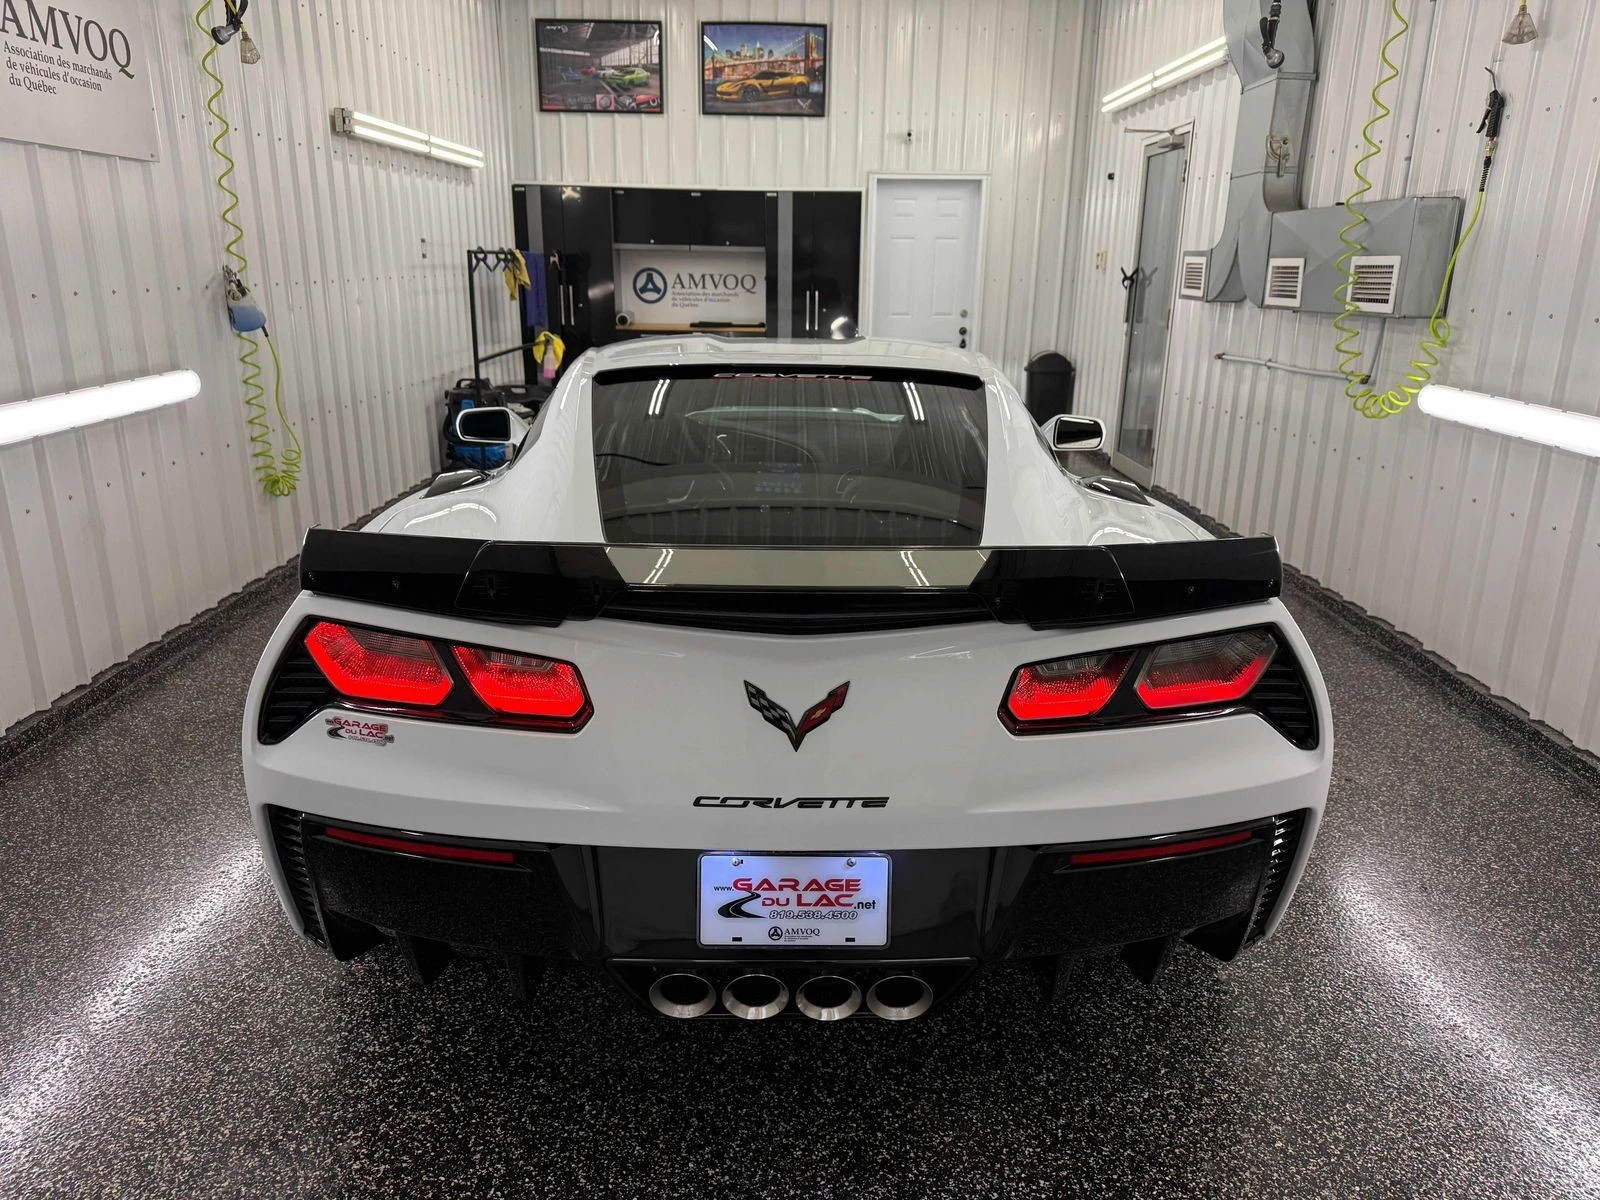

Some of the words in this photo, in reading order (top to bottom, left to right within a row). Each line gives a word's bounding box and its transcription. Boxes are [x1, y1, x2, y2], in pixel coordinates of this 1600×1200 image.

[0, 0, 135, 80] AMVOQ
[4, 40, 55, 66] Association
[56, 55, 71, 70] des
[72, 61, 113, 81] marchands
[6, 57, 18, 71] de
[20, 62, 61, 81] véhicules
[62, 71, 103, 92] d'occasion
[9, 73, 21, 88] du
[23, 76, 57, 95] Québec
[671, 272, 758, 295] AMVOQ
[333, 717, 388, 732] GARAGE
[359, 729, 384, 739] LAC
[693, 796, 891, 809] CORVETTE
[761, 897, 790, 907] DU
[768, 909, 859, 920] 819.538.4500
[784, 927, 821, 937] AMVOQ
